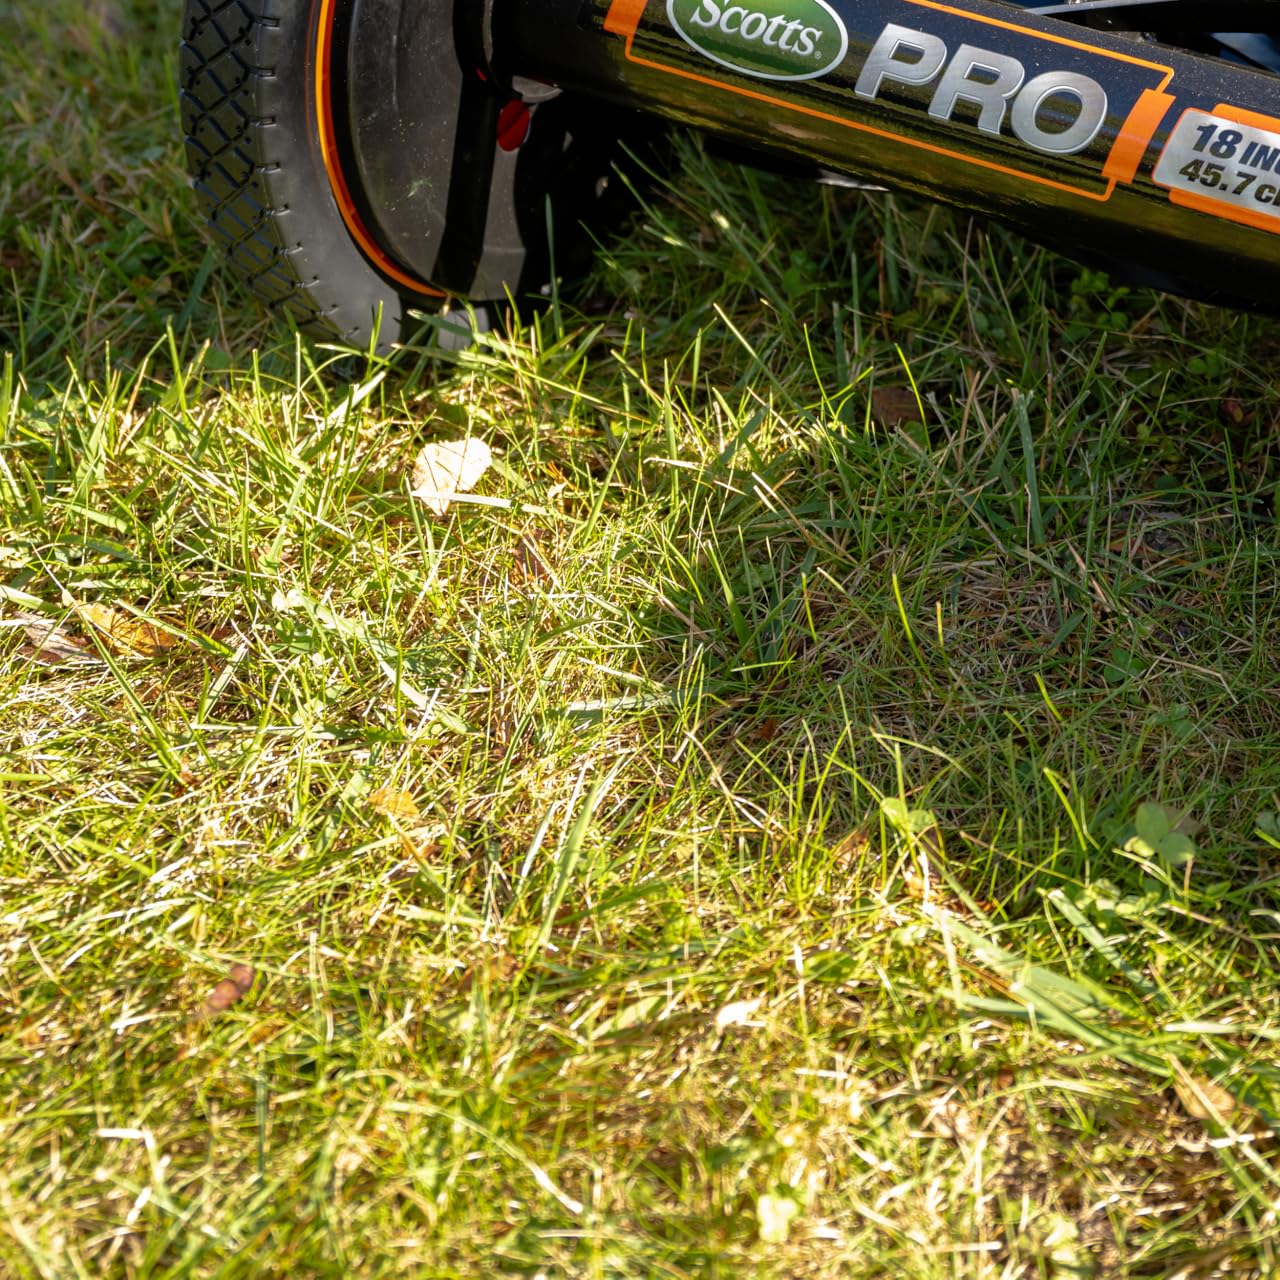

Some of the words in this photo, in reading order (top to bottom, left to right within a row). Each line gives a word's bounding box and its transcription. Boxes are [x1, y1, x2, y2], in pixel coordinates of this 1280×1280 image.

[854, 22, 1108, 155] PRO
[1192, 124, 1243, 160] 18
[1179, 158, 1257, 196] 45.7
